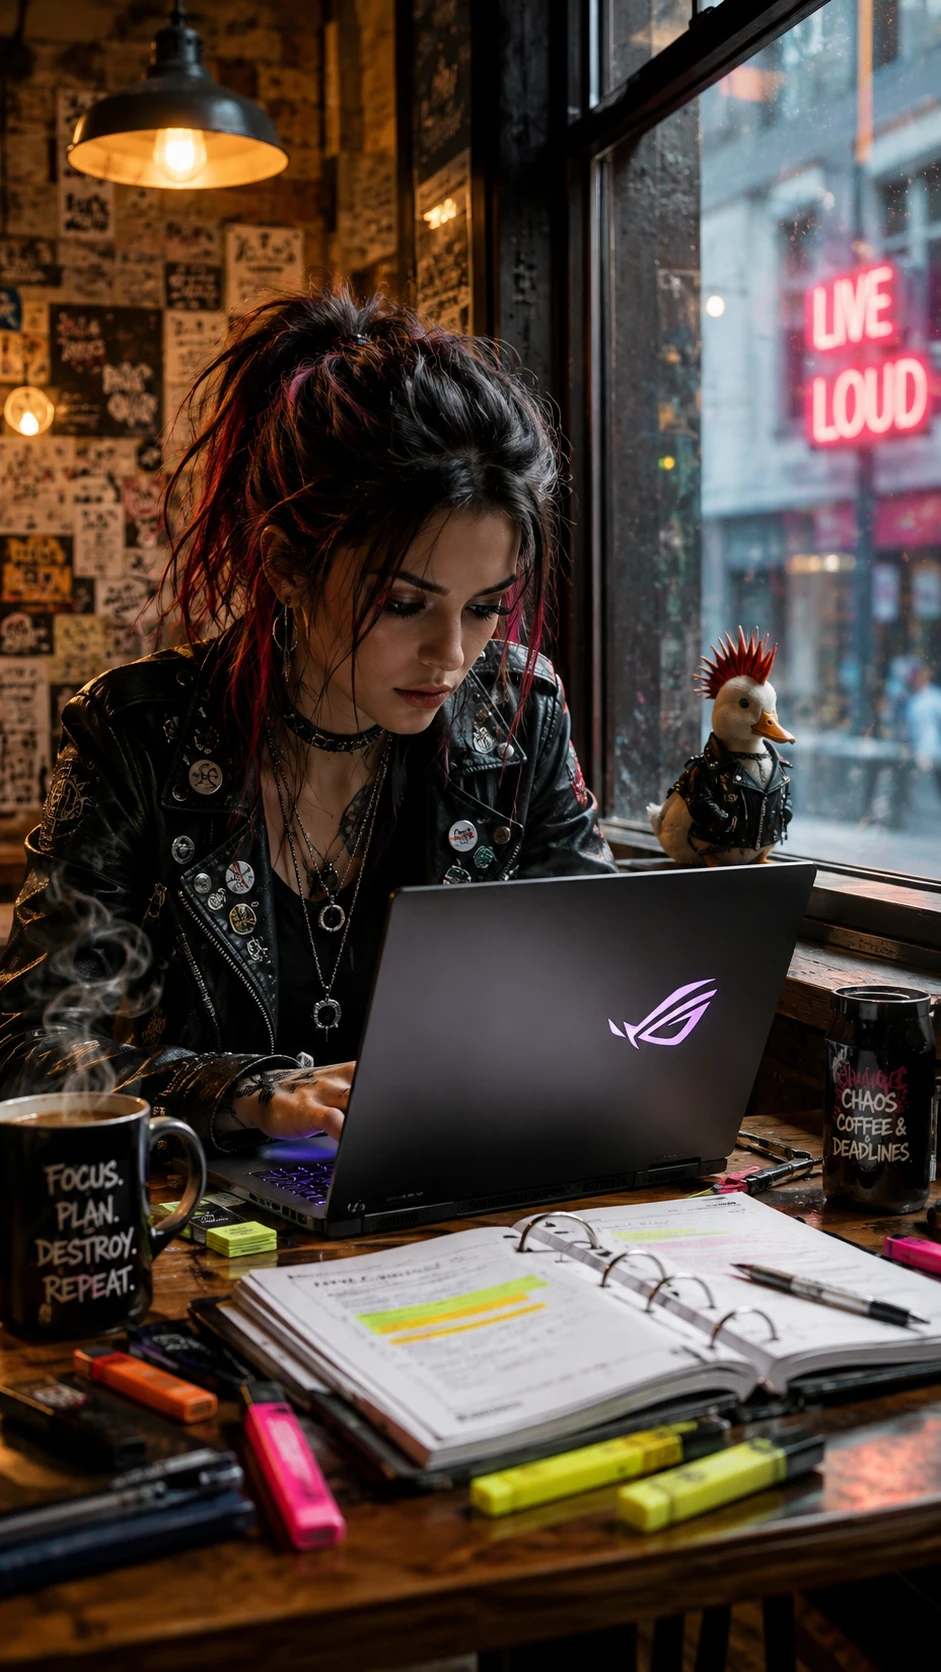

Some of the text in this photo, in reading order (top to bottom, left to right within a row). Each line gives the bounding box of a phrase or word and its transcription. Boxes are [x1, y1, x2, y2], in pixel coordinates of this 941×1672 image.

[813, 266, 893, 350] LIVE
[813, 358, 928, 443] LOUD
[841, 1088, 898, 1114] CHAOS
[836, 1113, 907, 1137] COFFEE &
[43, 1159, 124, 1195] FOCUS.
[55, 1194, 120, 1231] PLAN.
[34, 1226, 137, 1267] DESTROY.
[42, 1265, 135, 1303] REPEAT.
